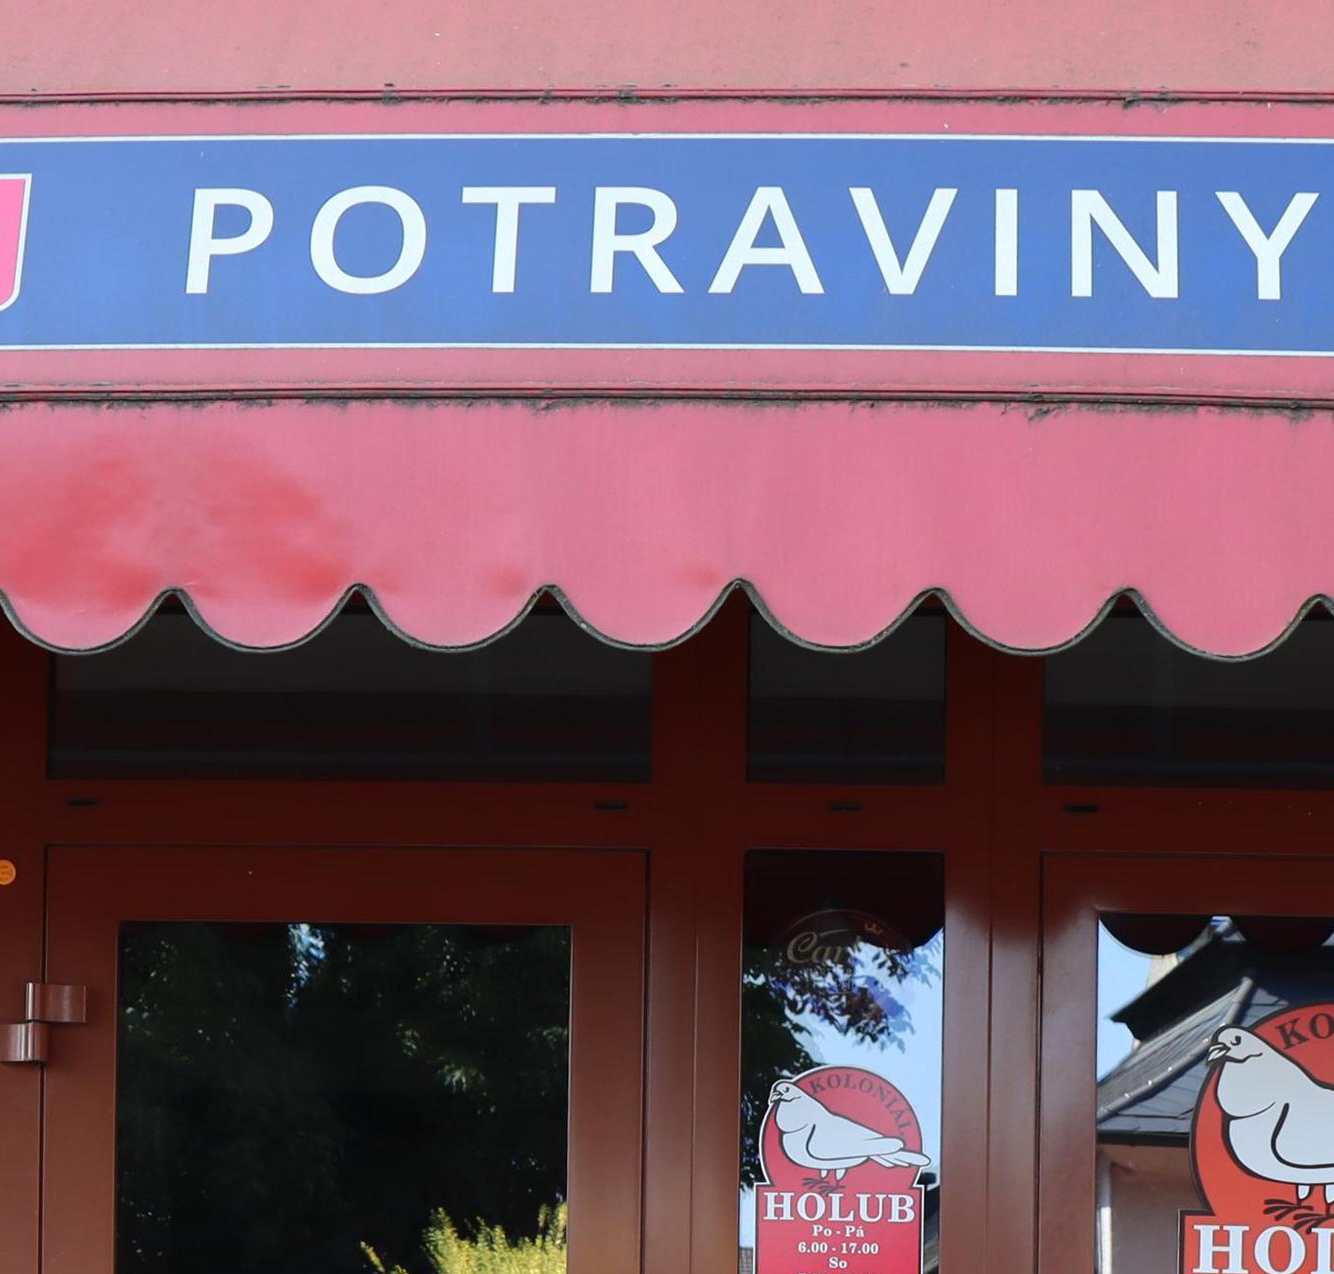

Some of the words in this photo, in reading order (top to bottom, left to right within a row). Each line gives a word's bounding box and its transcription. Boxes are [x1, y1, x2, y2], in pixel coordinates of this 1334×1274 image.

[186, 185, 1319, 300] POTRAVINY
[808, 1073, 914, 1136] KOLONIÁL
[763, 1192, 915, 1222] HOLUB
[812, 1225, 832, 1237] Po
[845, 1225, 864, 1237] Pá
[798, 1242, 828, 1254] 6.00
[842, 1243, 879, 1254] 17.00
[829, 1257, 847, 1269] So
